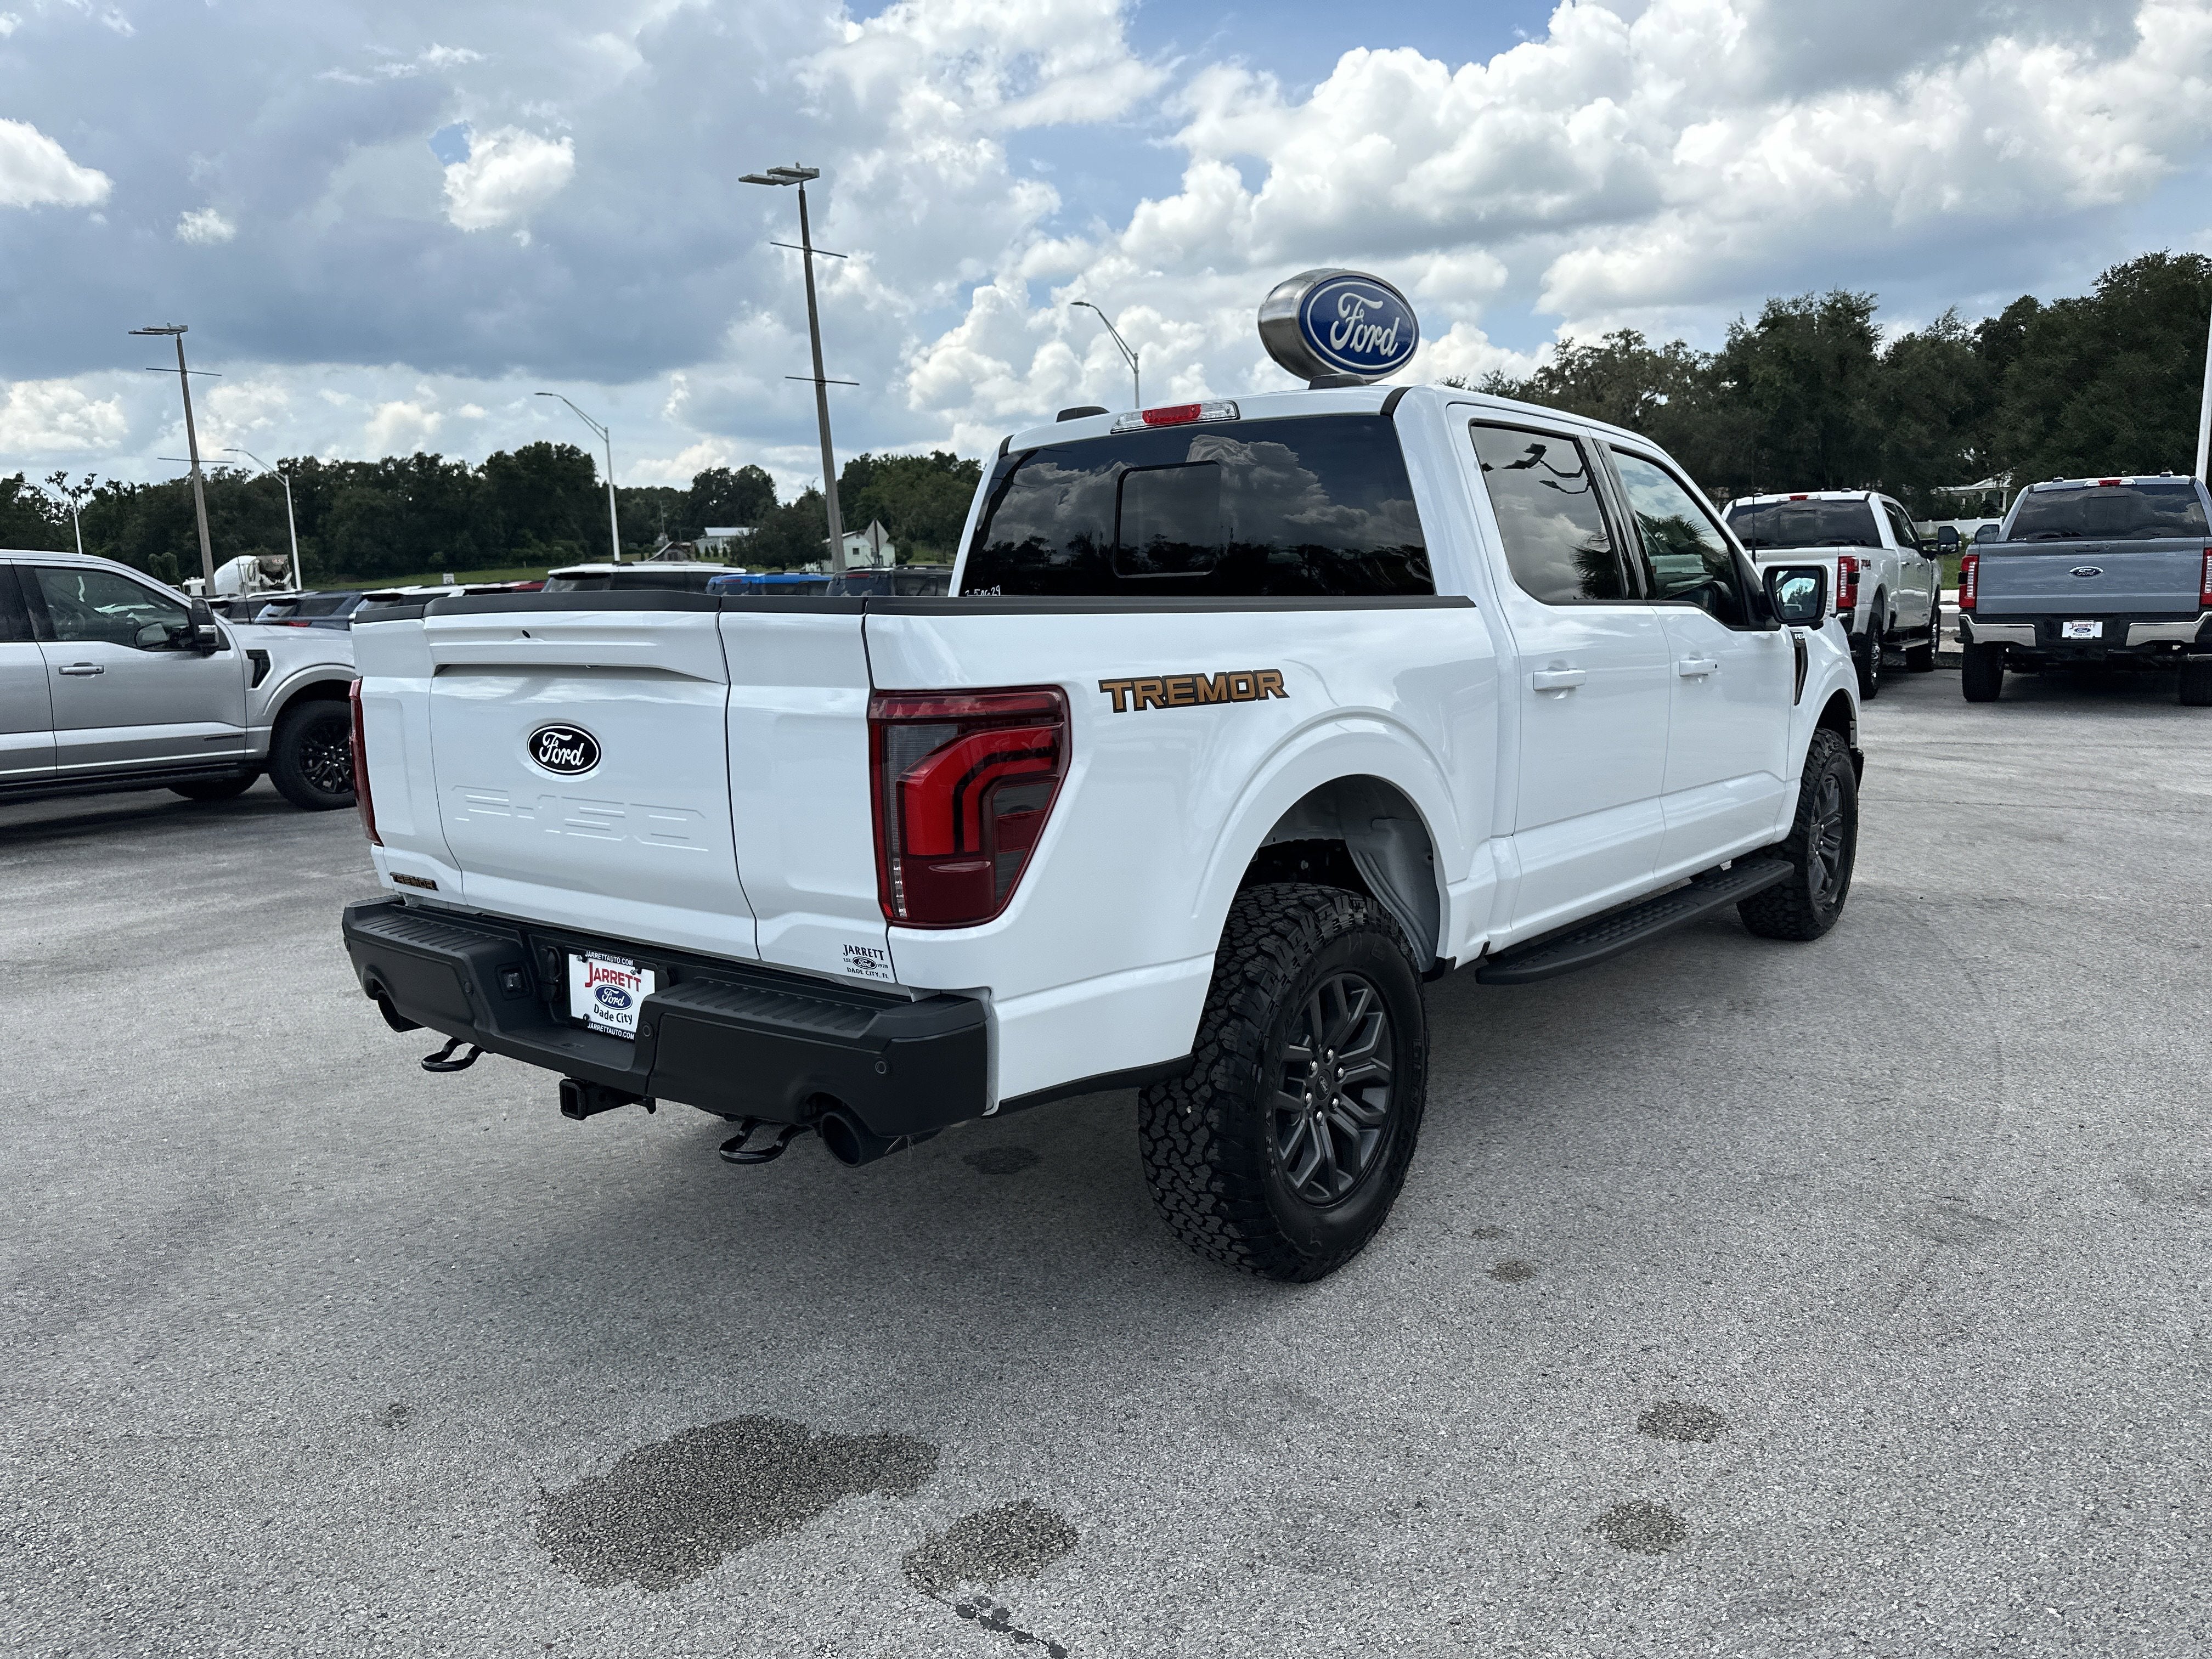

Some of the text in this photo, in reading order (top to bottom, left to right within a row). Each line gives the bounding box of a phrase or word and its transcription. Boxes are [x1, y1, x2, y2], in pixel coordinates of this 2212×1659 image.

[1330, 292, 1400, 357] Ford
[1098, 668, 1290, 714] TREMOR
[539, 731, 585, 766] Ford
[390, 871, 439, 891] TREMOR
[585, 951, 634, 966] JARRETTAUTO.COM
[843, 944, 884, 961] JARRETT
[585, 962, 641, 992] JARRETT
[601, 988, 625, 1007] Ford
[594, 1003, 633, 1025] Dade City
[587, 1022, 635, 1040] JARRETTAUTO.COM
